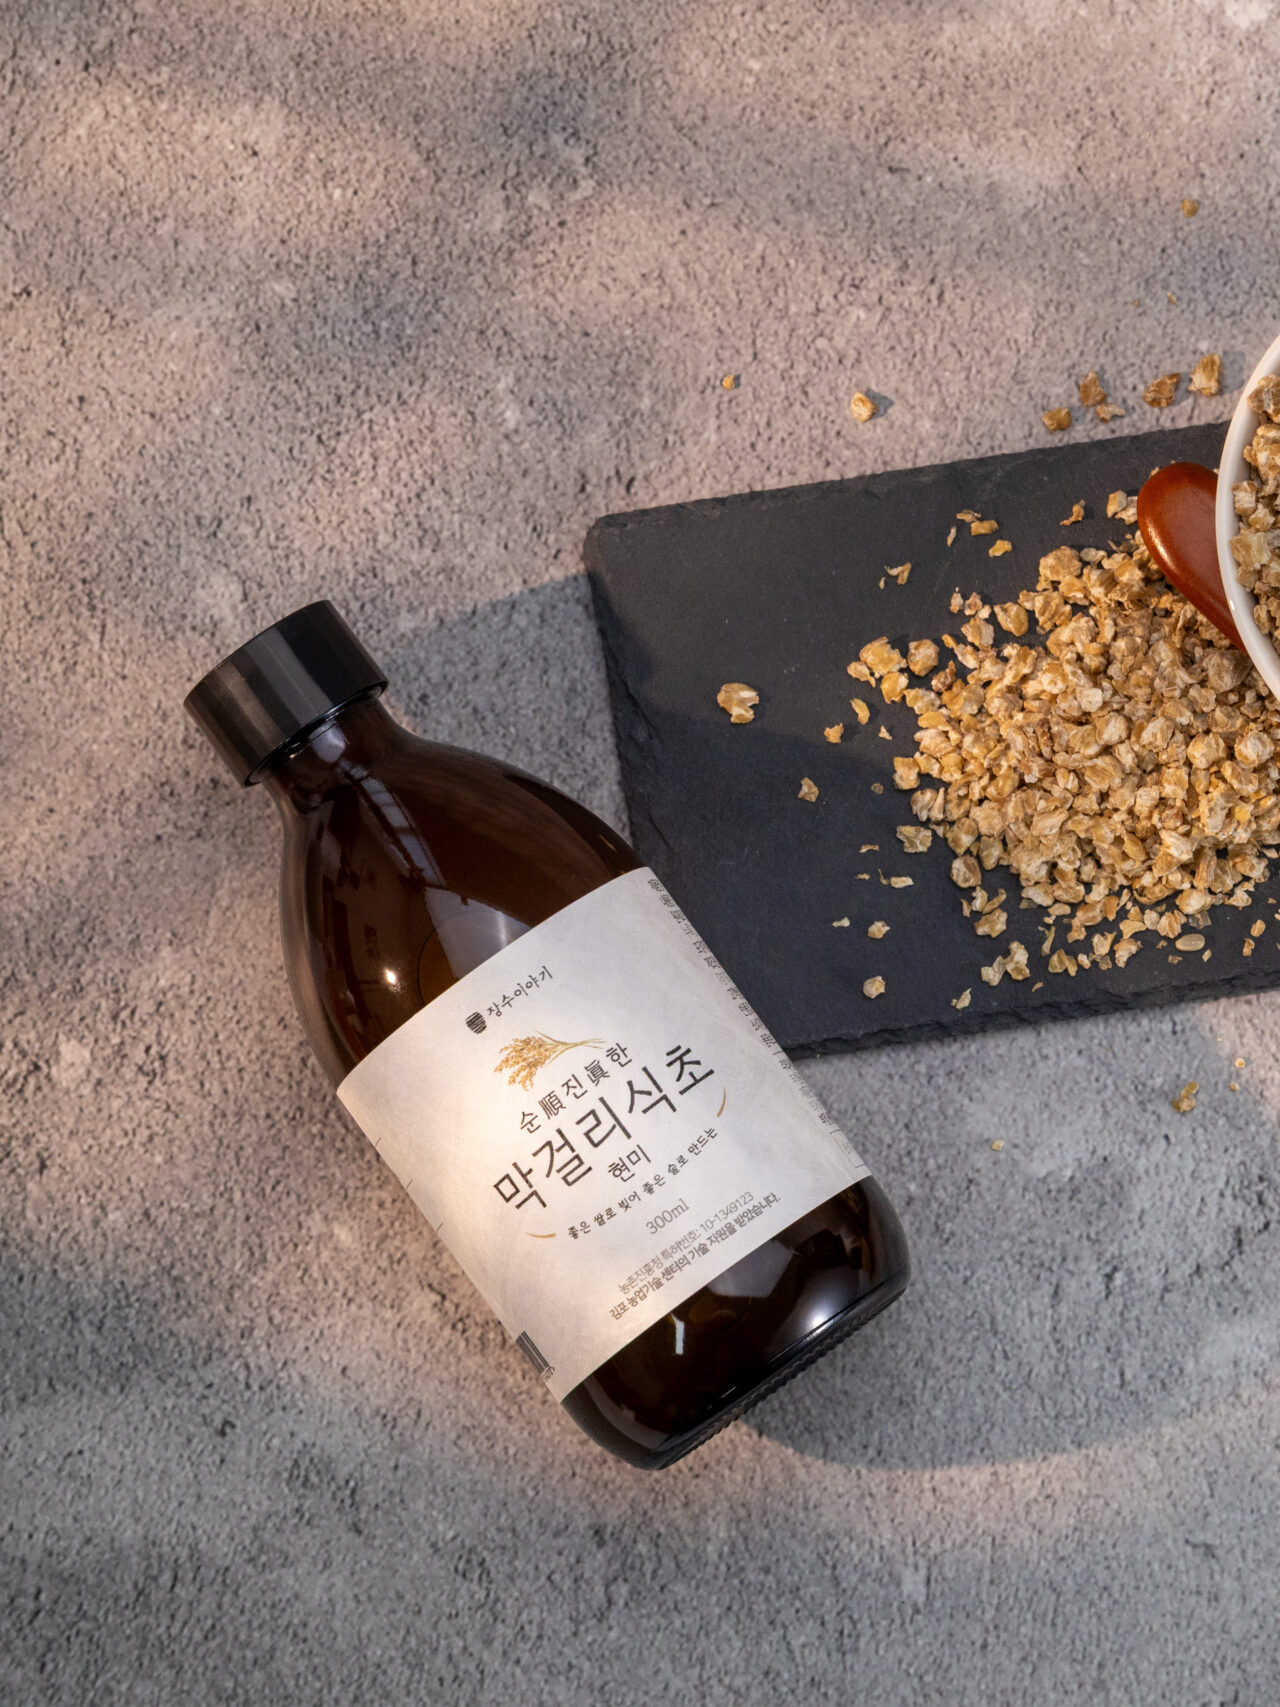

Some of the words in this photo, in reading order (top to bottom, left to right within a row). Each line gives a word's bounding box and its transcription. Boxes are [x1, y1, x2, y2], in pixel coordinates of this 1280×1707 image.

[486, 965, 553, 1018] 장수이야기
[492, 1044, 715, 1210] 막걸리식초
[607, 1143, 652, 1183] 현미
[567, 1220, 592, 1240] 좋은
[593, 1207, 617, 1227] 쌀로
[617, 1190, 642, 1213] 빚어
[641, 1174, 667, 1195] 좋은
[667, 1154, 689, 1176] 술로
[687, 1127, 718, 1157] 만드는
[645, 1197, 691, 1235] 300ml
[609, 1301, 630, 1321] 김포
[625, 1276, 665, 1308] 농업기술
[660, 1253, 692, 1282] 센터의
[687, 1242, 711, 1261] 기술
[705, 1221, 738, 1247] 지원을
[732, 1192, 782, 1229] 받았습니다.
[617, 1254, 664, 1296] 농촌진흥청
[659, 1228, 702, 1261] 특허번호:
[699, 1191, 755, 1233] 10-1349123
